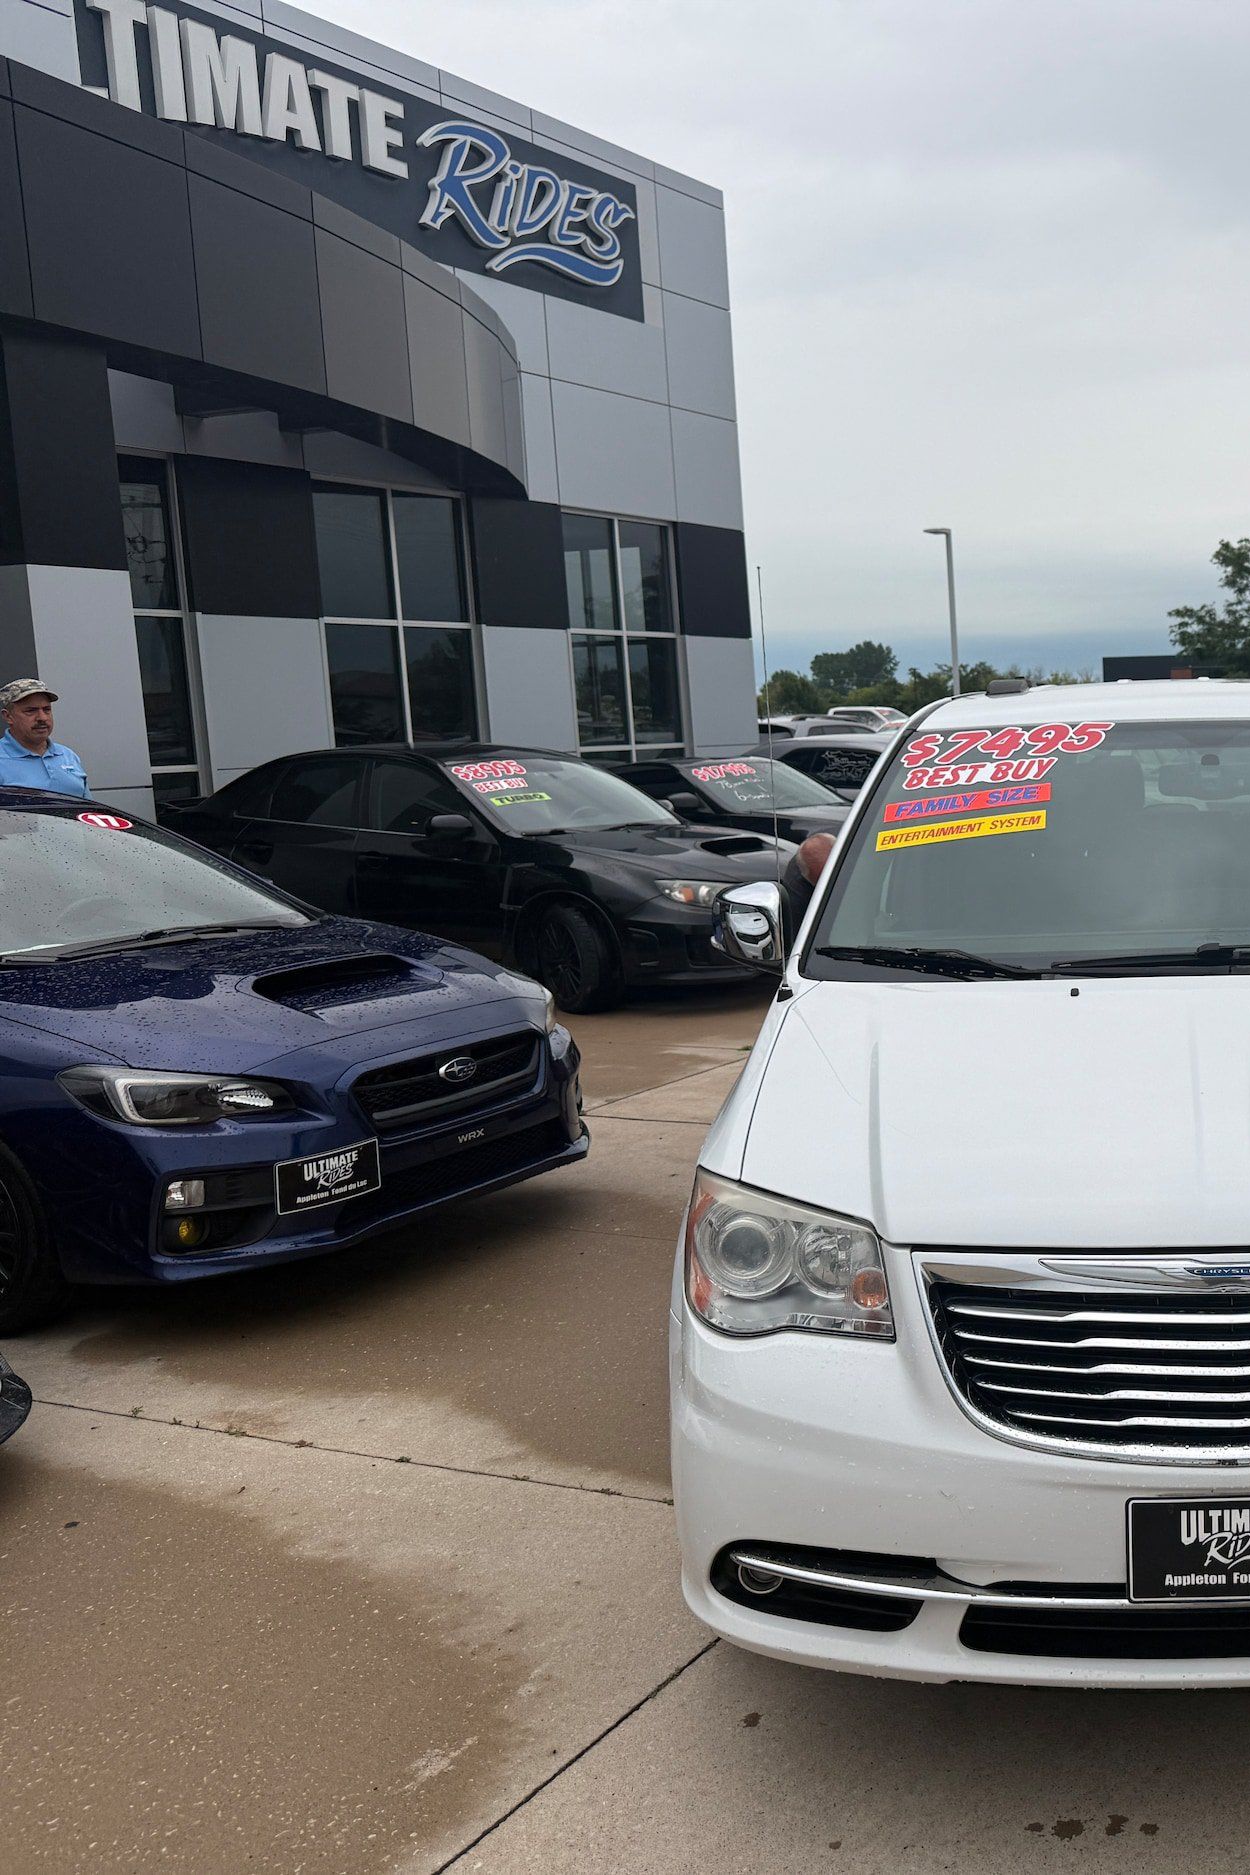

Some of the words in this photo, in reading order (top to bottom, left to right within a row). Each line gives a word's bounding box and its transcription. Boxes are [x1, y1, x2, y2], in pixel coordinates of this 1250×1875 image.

[81, 0, 408, 180] TIMATE
[901, 721, 1115, 768] $7495
[452, 760, 527, 781] $8995
[903, 763, 988, 790] BEST
[989, 757, 1058, 782] BUY
[473, 780, 504, 793] BEST
[504, 778, 528, 789] BUY
[895, 794, 977, 818] FAMILY
[987, 786, 1041, 805] SIZE
[87, 814, 120, 828] 17
[880, 822, 985, 846] ENTERTAINMENT
[989, 815, 1042, 830] SYSTEM
[458, 1128, 485, 1144] WRX
[303, 1150, 359, 1181] ULTIMATE
[296, 1191, 330, 1204] Appleton
[331, 1185, 348, 1196] Fond
[348, 1183, 357, 1191] du
[1165, 1573, 1227, 1587] Appleton
